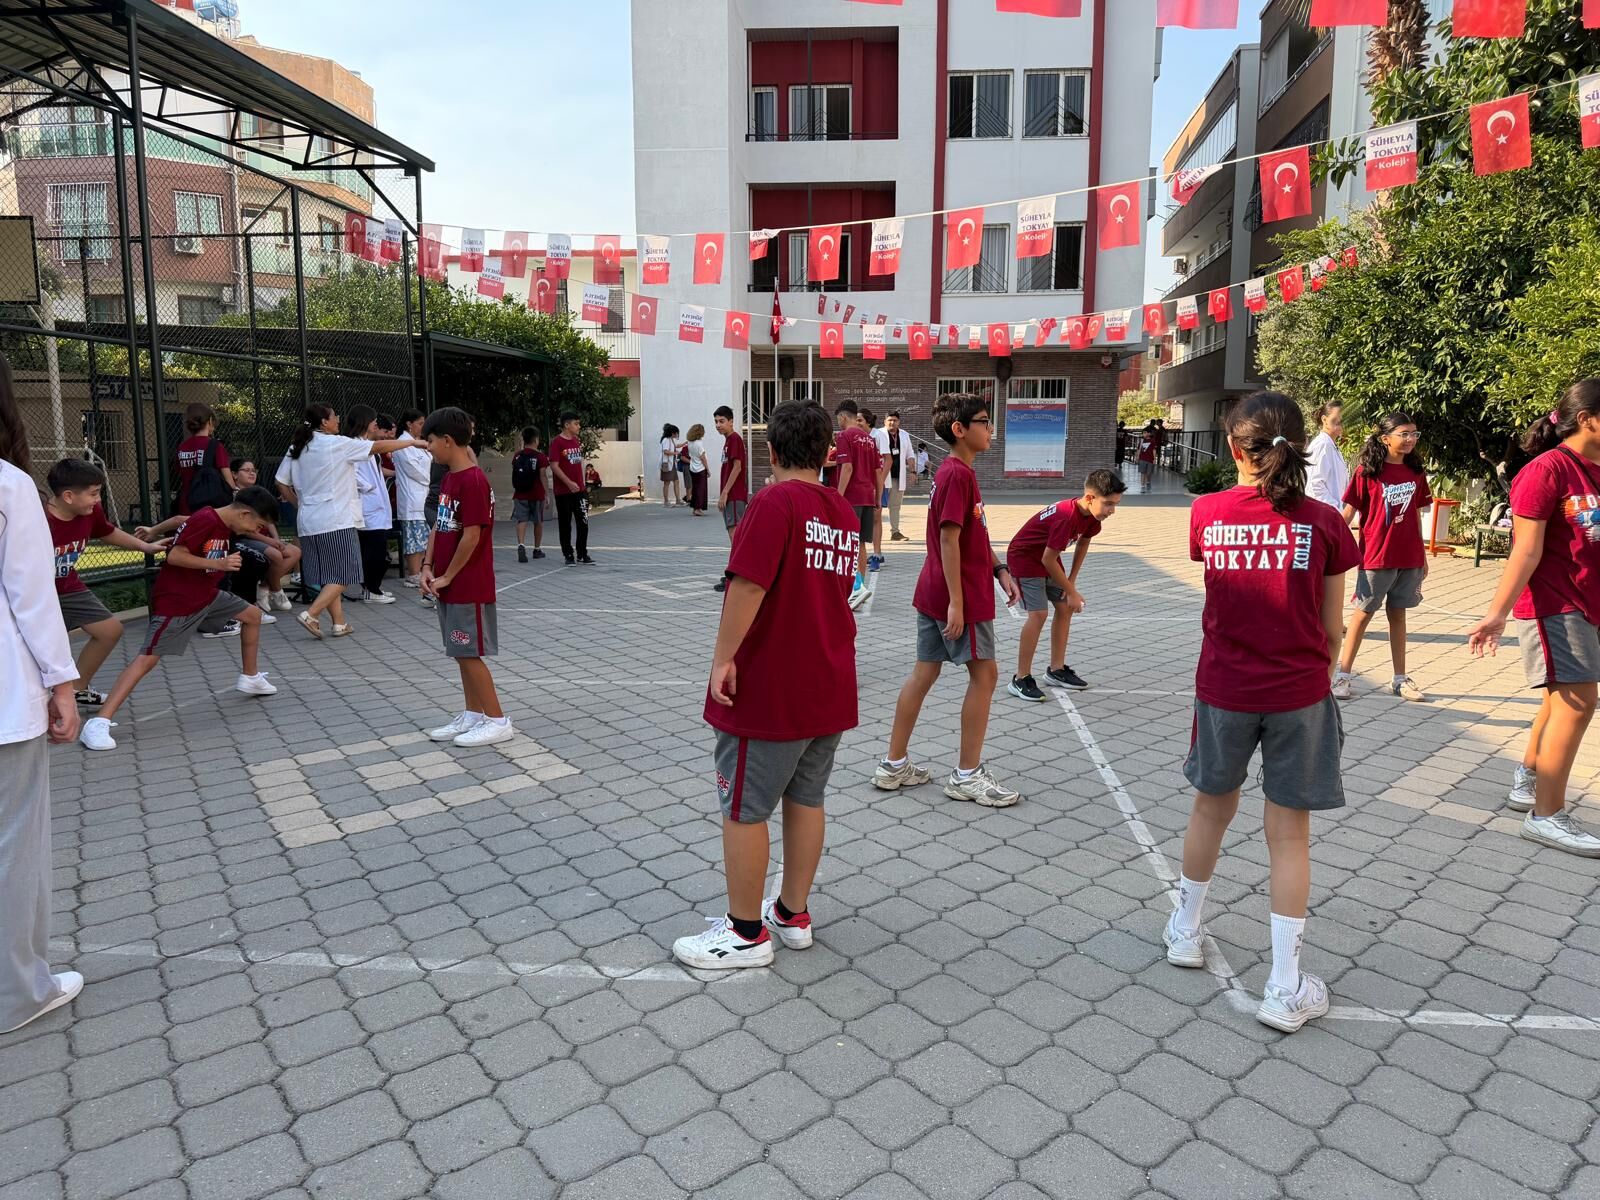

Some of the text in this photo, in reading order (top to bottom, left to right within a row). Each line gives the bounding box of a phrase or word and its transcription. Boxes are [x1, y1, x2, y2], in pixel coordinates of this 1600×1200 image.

[1370, 132, 1413, 147] SÜHEYLA
[1373, 144, 1412, 157] TOKYAY
[1020, 212, 1052, 223] SÜHEYLA
[1022, 222, 1049, 231] TOKYAY
[1203, 520, 1289, 546] SÜHEYLA
[1203, 549, 1288, 570] TOKYAY
